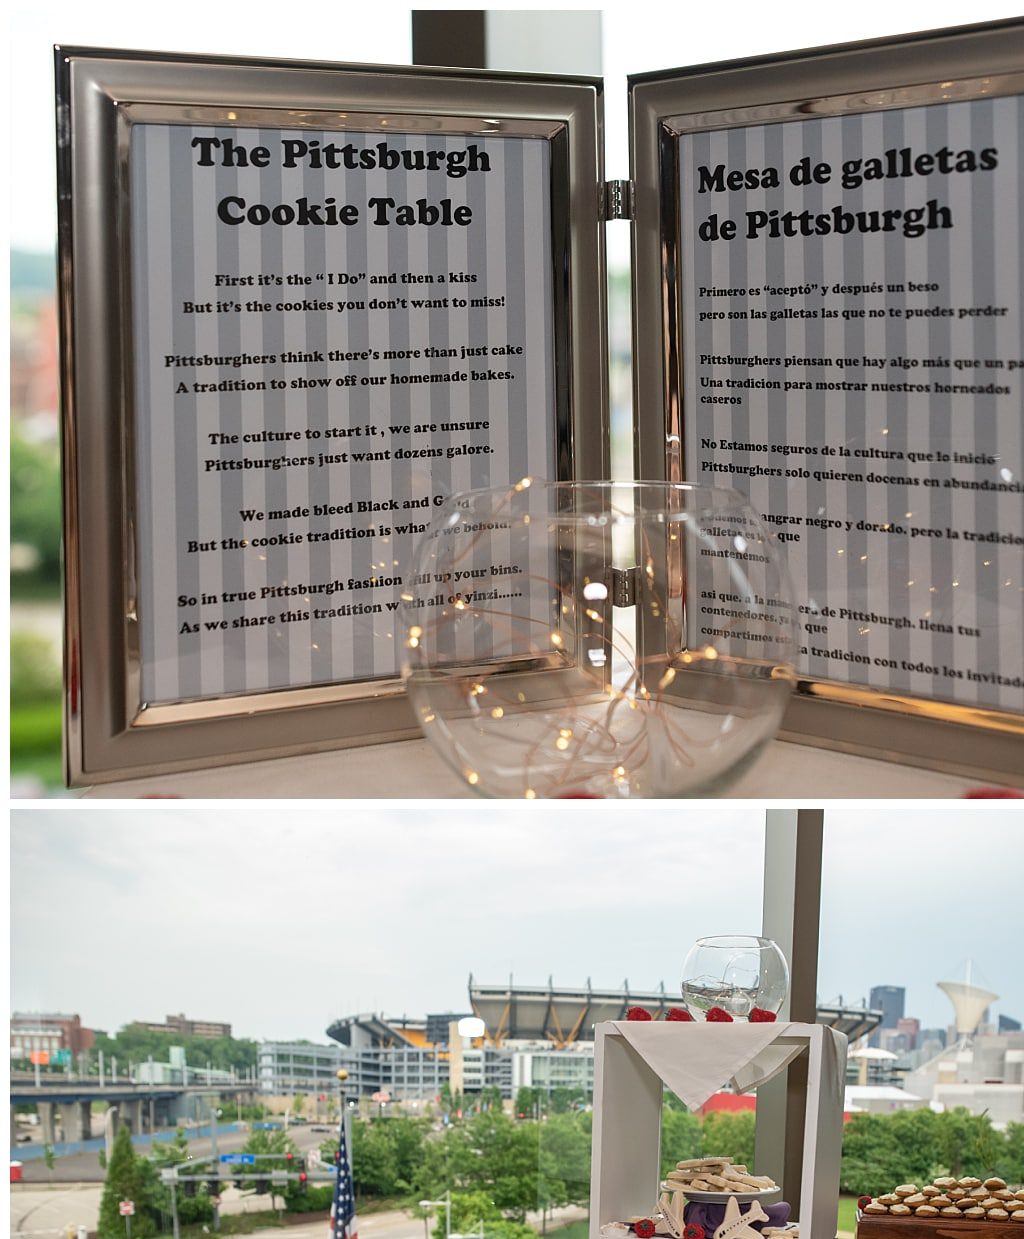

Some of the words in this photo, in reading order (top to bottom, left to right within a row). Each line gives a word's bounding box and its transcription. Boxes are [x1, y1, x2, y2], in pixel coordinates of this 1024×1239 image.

[191, 137, 270, 167] The
[282, 140, 491, 178] Pittsburgh
[698, 165, 780, 193] Mesa
[790, 157, 831, 186] de
[842, 147, 997, 189] galletas
[218, 196, 358, 225] Cookie
[368, 198, 472, 226] Table
[699, 214, 736, 241] de
[745, 199, 953, 239] Pittsburgh
[215, 275, 254, 286] First
[287, 274, 311, 285] the
[328, 274, 333, 284] I
[370, 273, 397, 284] and
[400, 273, 434, 283] then
[438, 275, 445, 283] a
[449, 272, 477, 282] kiss
[699, 287, 746, 297] Primero
[821, 287, 829, 296] y
[832, 282, 883, 295] después
[908, 282, 939, 291] beso
[184, 302, 212, 313] But
[246, 301, 271, 312] the
[276, 300, 333, 311] cookies
[338, 302, 364, 312] you
[411, 298, 448, 308] want
[452, 298, 467, 307] to
[471, 296, 504, 307] miss!
[700, 312, 725, 321] pero
[751, 309, 767, 319] las
[770, 309, 818, 321] galletas
[821, 308, 838, 318] las
[842, 310, 865, 320] que
[889, 308, 902, 317] te
[905, 306, 954, 319] puedes
[959, 306, 1007, 318] perder
[165, 354, 276, 367] Pittsburghers
[280, 351, 324, 363] think
[384, 350, 420, 359] more
[424, 347, 457, 357] than
[461, 346, 488, 359] just
[492, 345, 523, 355] cake
[700, 355, 781, 367] Pittsburghers
[784, 356, 832, 367] piensan
[836, 359, 859, 368] que
[863, 357, 886, 369] hay
[890, 357, 918, 369] algo
[923, 357, 950, 367] más
[954, 360, 980, 370] que
[985, 360, 1003, 368] un
[176, 382, 188, 393] A
[193, 380, 266, 392] tradition
[270, 380, 286, 389] to
[291, 378, 331, 388] show
[336, 375, 357, 386] off
[361, 377, 386, 385] our
[391, 371, 467, 384] homemade
[471, 370, 514, 380] bakes.
[700, 377, 723, 387] Una
[726, 379, 781, 389] tradicion
[784, 382, 812, 391] para
[816, 382, 868, 391] mostrar
[872, 383, 930, 392] nuestros
[934, 382, 1009, 394] horneados
[701, 396, 741, 404] caseros
[209, 433, 238, 444] The
[243, 431, 300, 442] culture
[305, 429, 321, 439] to
[325, 427, 361, 438] start
[365, 425, 377, 436] it
[389, 426, 410, 434] we
[414, 424, 436, 433] are
[441, 421, 489, 431] unsure
[205, 456, 314, 471] Pittsburghers
[319, 453, 348, 467] just
[352, 450, 390, 462] want
[394, 447, 442, 459] dozens
[447, 445, 493, 458] galore.
[701, 439, 717, 449] No
[720, 440, 767, 452] Estamos
[771, 445, 818, 455] seguros
[821, 446, 836, 455] de
[839, 447, 851, 456] la
[854, 448, 904, 459] cultura
[907, 453, 933, 462] que
[937, 451, 950, 461] lo
[702, 461, 782, 476] Pittsburghers
[785, 468, 810, 478] solo
[813, 470, 863, 482] quieren
[866, 473, 919, 485] docenas
[924, 479, 939, 487] en
[240, 510, 264, 521] We
[269, 507, 309, 519] made
[314, 503, 353, 516] bleed
[357, 500, 399, 512] Black
[403, 497, 429, 509] and
[188, 541, 216, 552] But
[221, 538, 246, 550] the
[252, 533, 302, 547] cookie
[307, 528, 375, 542] tradition
[380, 526, 391, 536] is
[778, 533, 800, 543] que
[806, 518, 841, 529] negro
[846, 522, 852, 531] y
[911, 528, 942, 537] pero
[947, 528, 958, 539] la
[178, 595, 197, 607] So
[202, 594, 217, 604] in
[222, 592, 256, 602] true
[261, 581, 344, 598] Pittsburgh
[434, 573, 451, 583] up
[455, 569, 487, 581] your
[490, 565, 522, 575] bins.
[180, 622, 199, 634] As
[205, 621, 228, 630] we
[233, 616, 275, 628] share
[280, 610, 309, 622] this
[313, 604, 382, 619] tradition
[428, 595, 444, 605] all
[701, 590, 716, 599] asi
[821, 607, 835, 617] de
[920, 620, 953, 633] llena
[805, 624, 827, 634] que
[701, 628, 772, 641] compartimos
[811, 647, 870, 664] tradicion
[874, 659, 897, 668] con
[902, 661, 939, 675] todos
[943, 666, 962, 678] los
